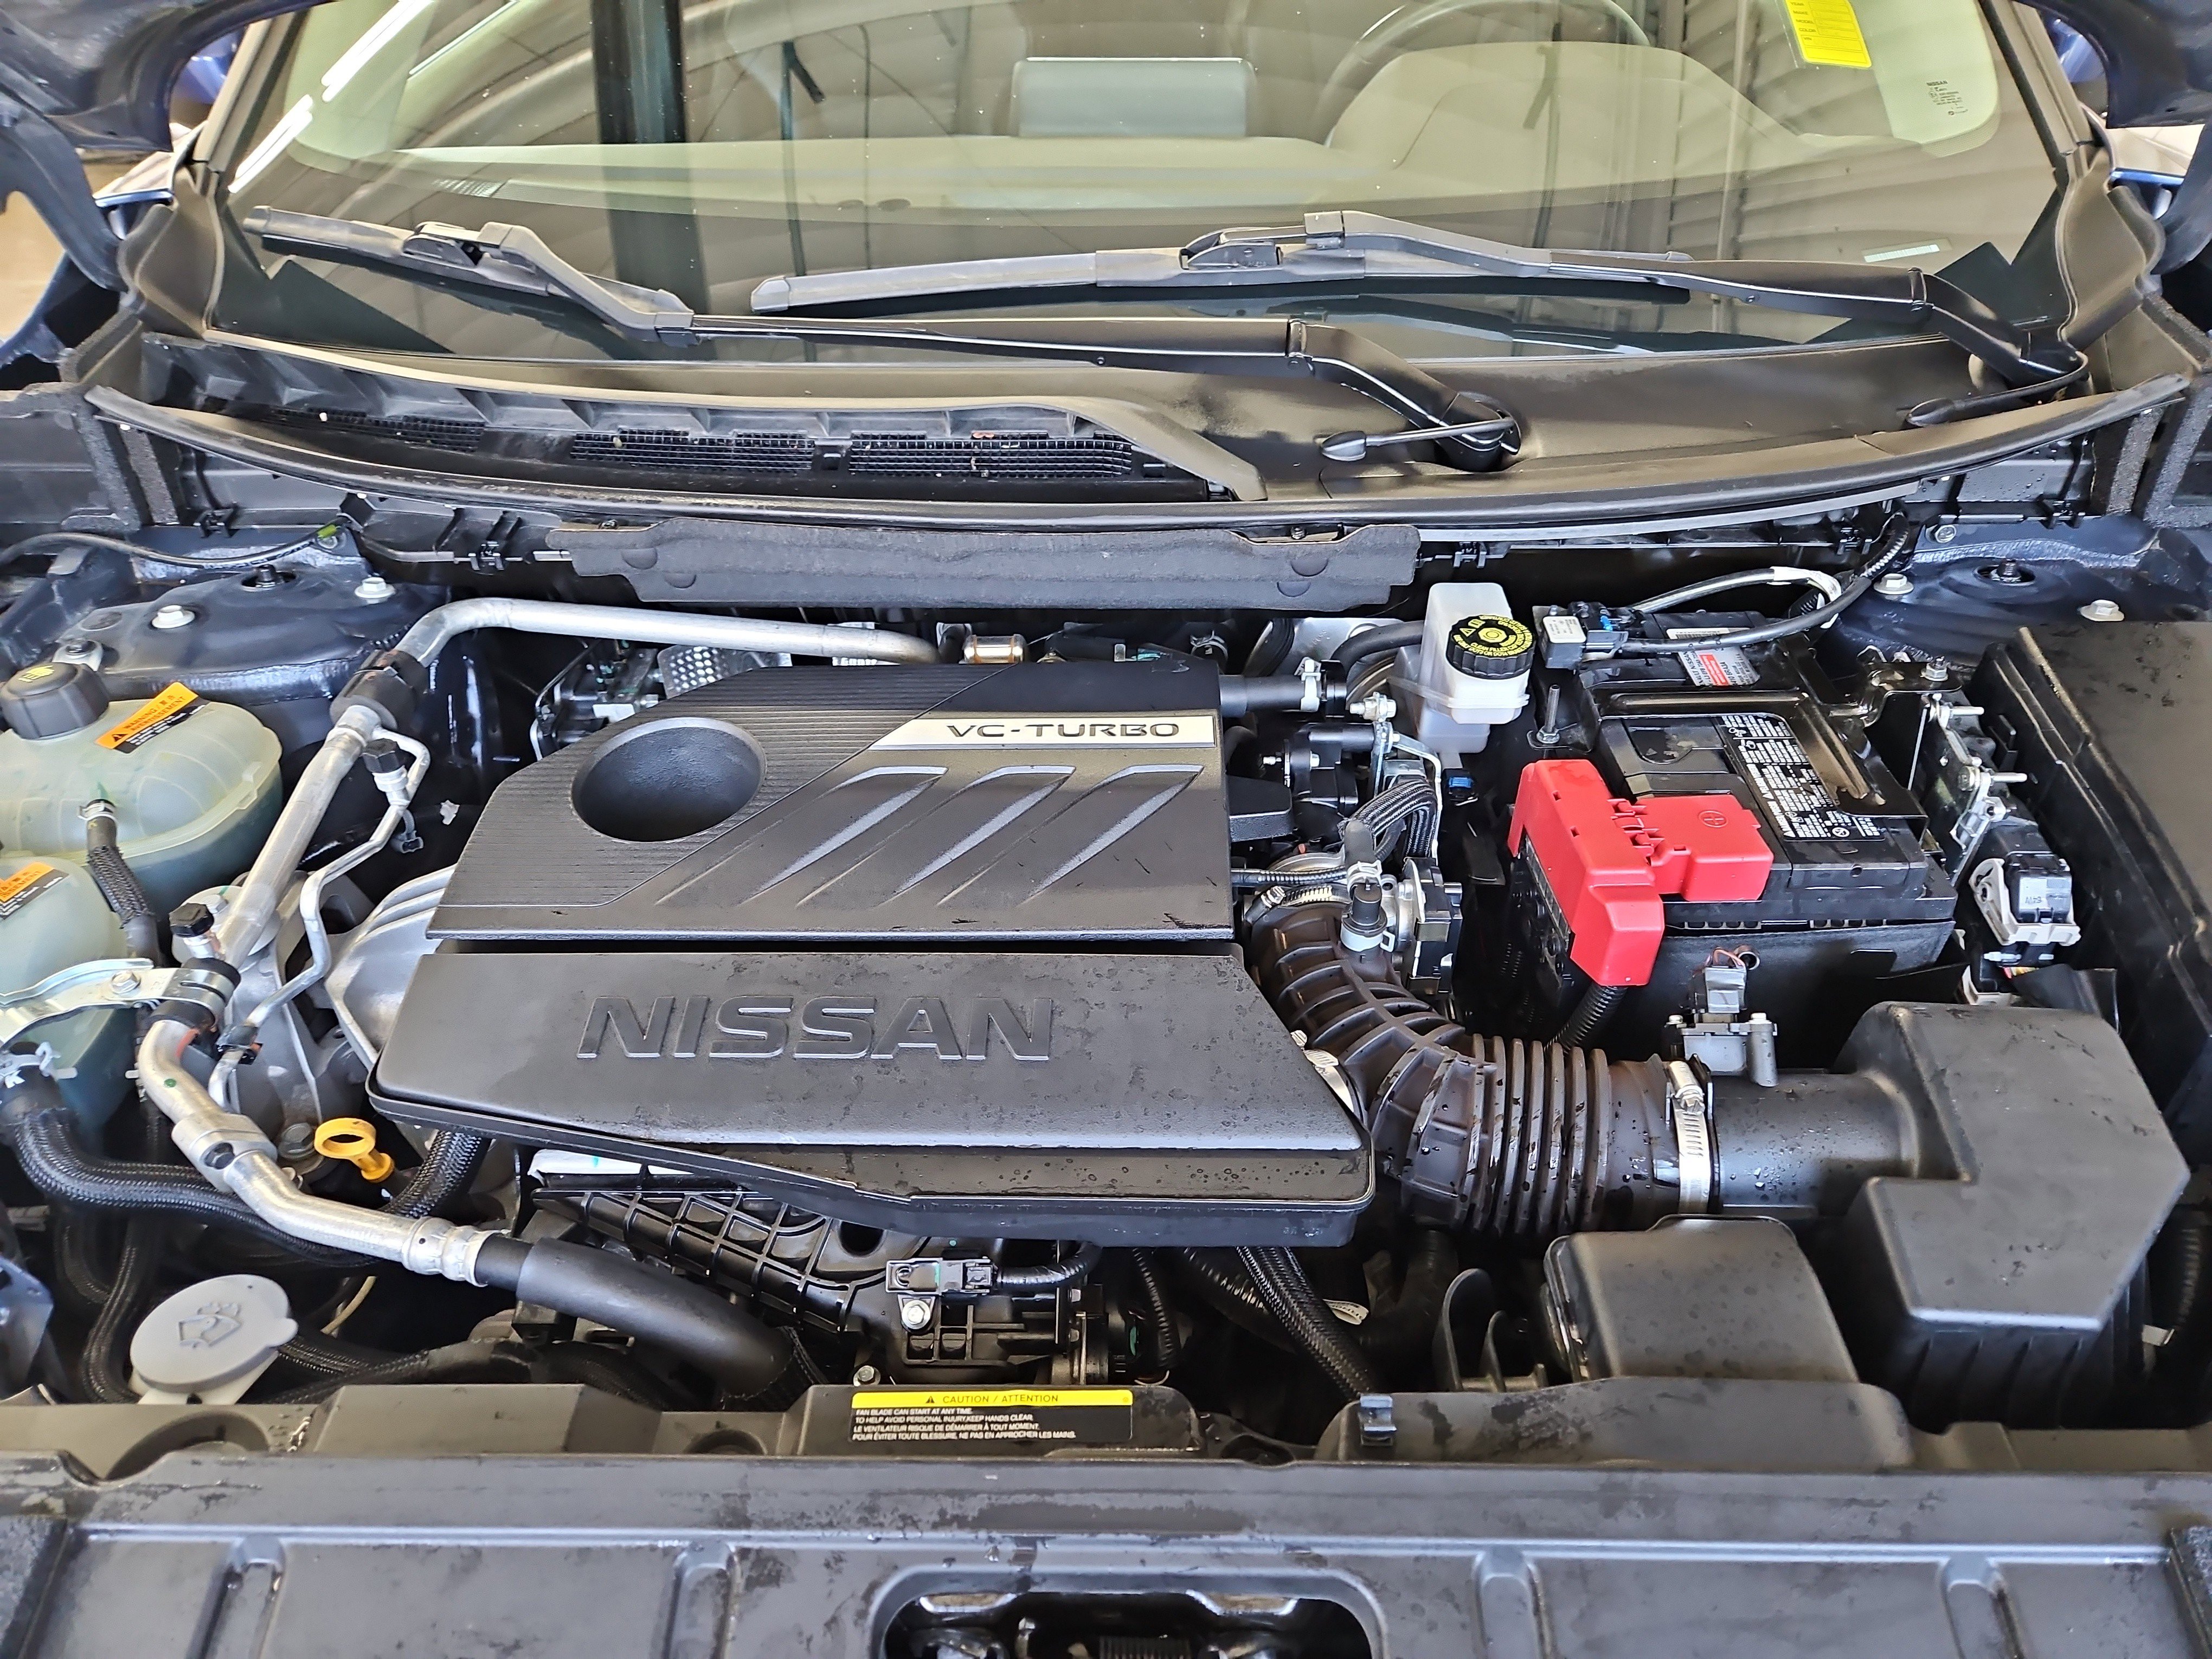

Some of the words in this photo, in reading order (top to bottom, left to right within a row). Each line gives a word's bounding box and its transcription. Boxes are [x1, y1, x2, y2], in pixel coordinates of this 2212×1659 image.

[123, 708, 157, 730] WARNING
[129, 696, 187, 731] AVERTISSEMENT
[946, 724, 1180, 737] VC-TURBO
[576, 996, 1053, 1060] NISSAN
[942, 1395, 989, 1404] CAUTION
[1001, 1394, 1059, 1403] ATTENTION
[945, 1422, 983, 1431] DÉMARRER
[983, 1422, 989, 1431] À
[874, 1431, 897, 1441] ÉVITER
[995, 1431, 1038, 1439] APPROCHER
